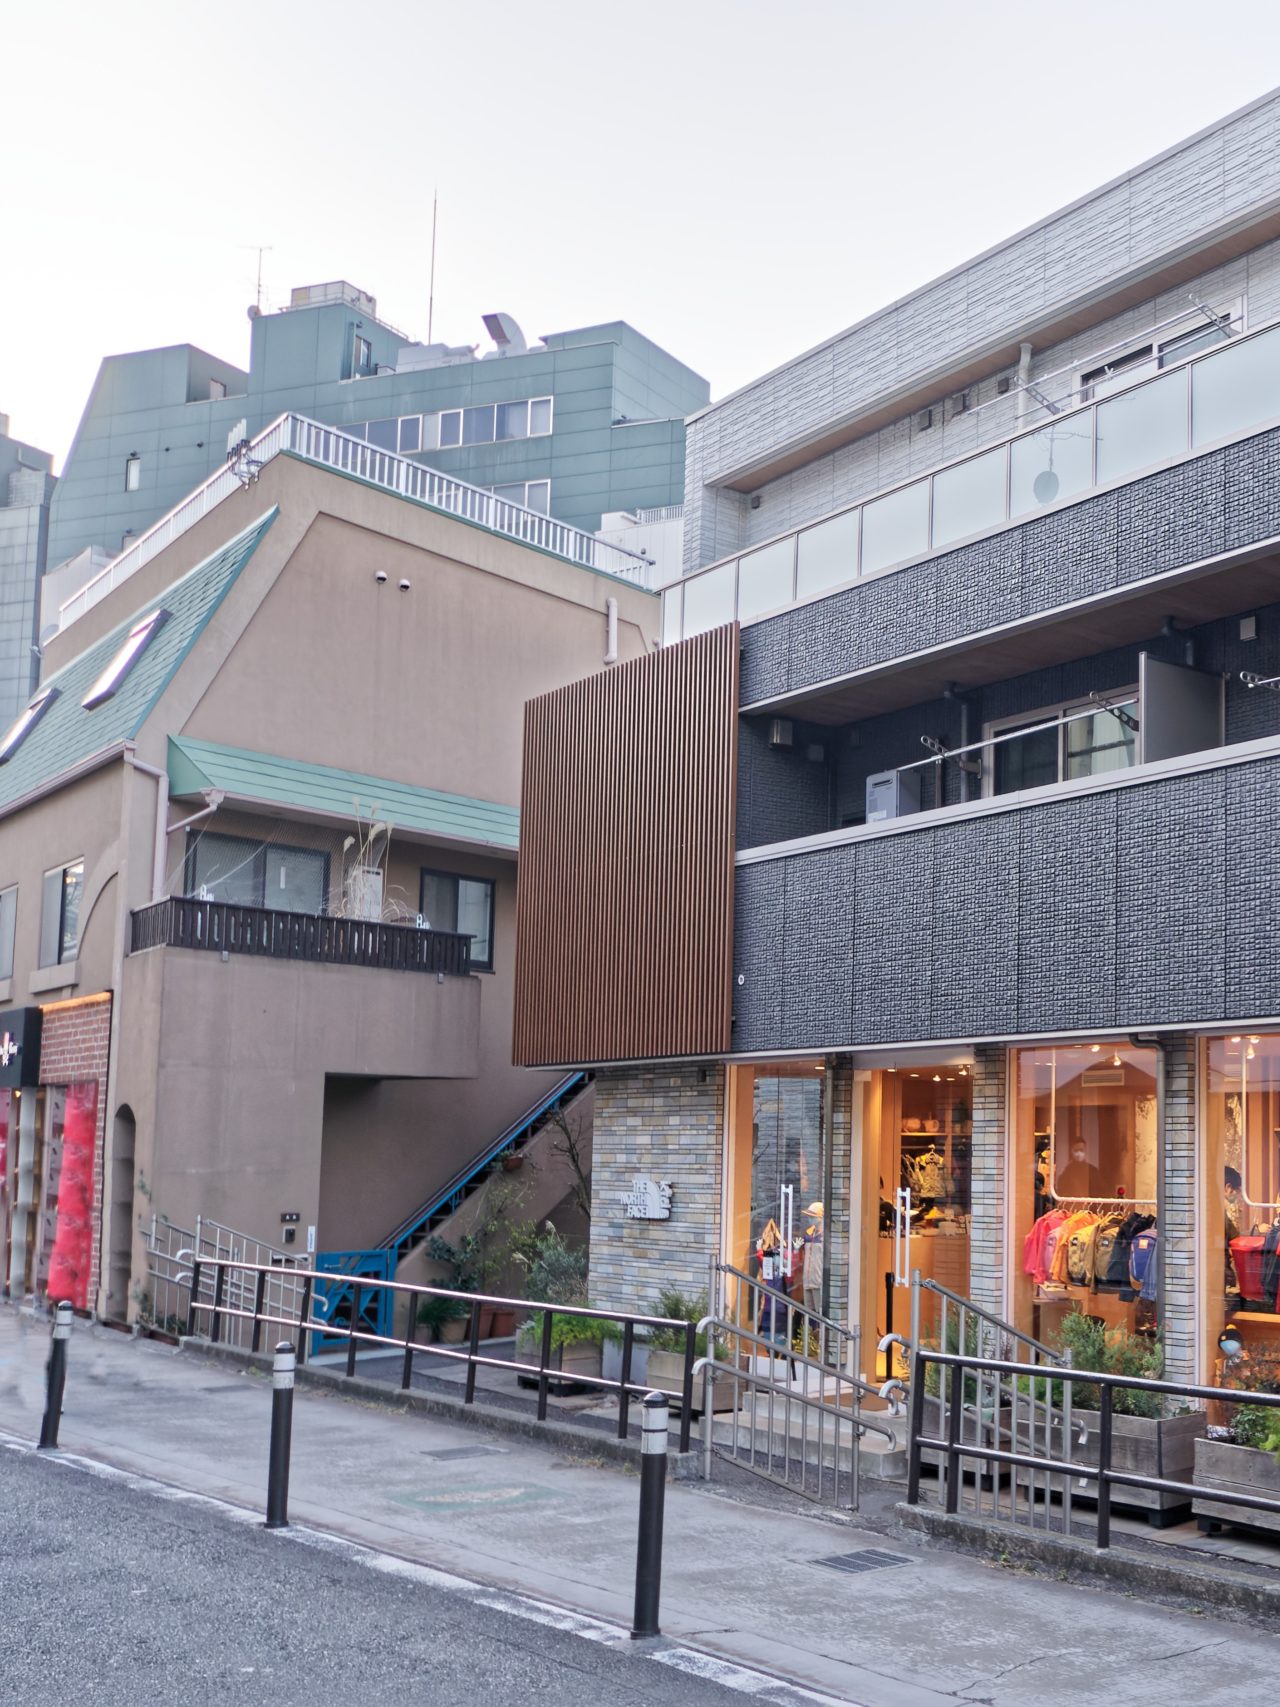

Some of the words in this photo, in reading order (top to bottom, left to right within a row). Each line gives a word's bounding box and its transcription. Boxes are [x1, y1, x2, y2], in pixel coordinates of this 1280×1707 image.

[632, 1180, 648, 1193] THE
[620, 1192, 648, 1205] NORTH
[627, 1205, 648, 1218] FACE
